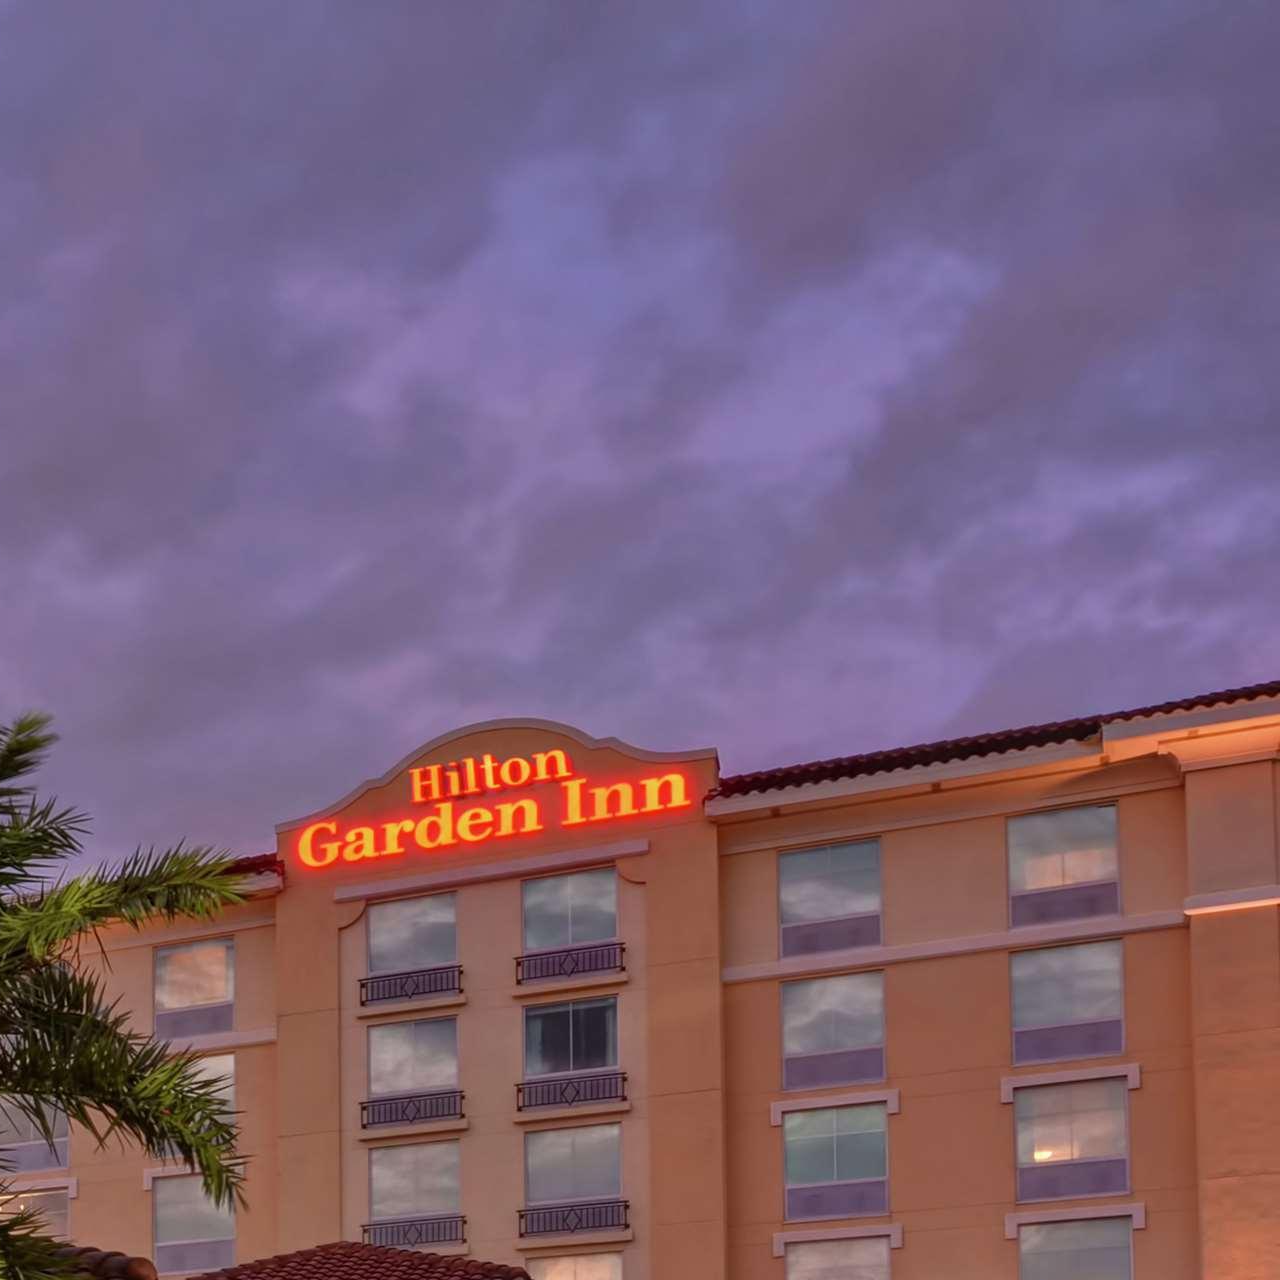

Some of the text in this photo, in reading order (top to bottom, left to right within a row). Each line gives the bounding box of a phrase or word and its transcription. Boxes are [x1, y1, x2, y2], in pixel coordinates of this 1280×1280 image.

[409, 749, 572, 803] Hilton
[297, 772, 691, 868] Garden Inn
